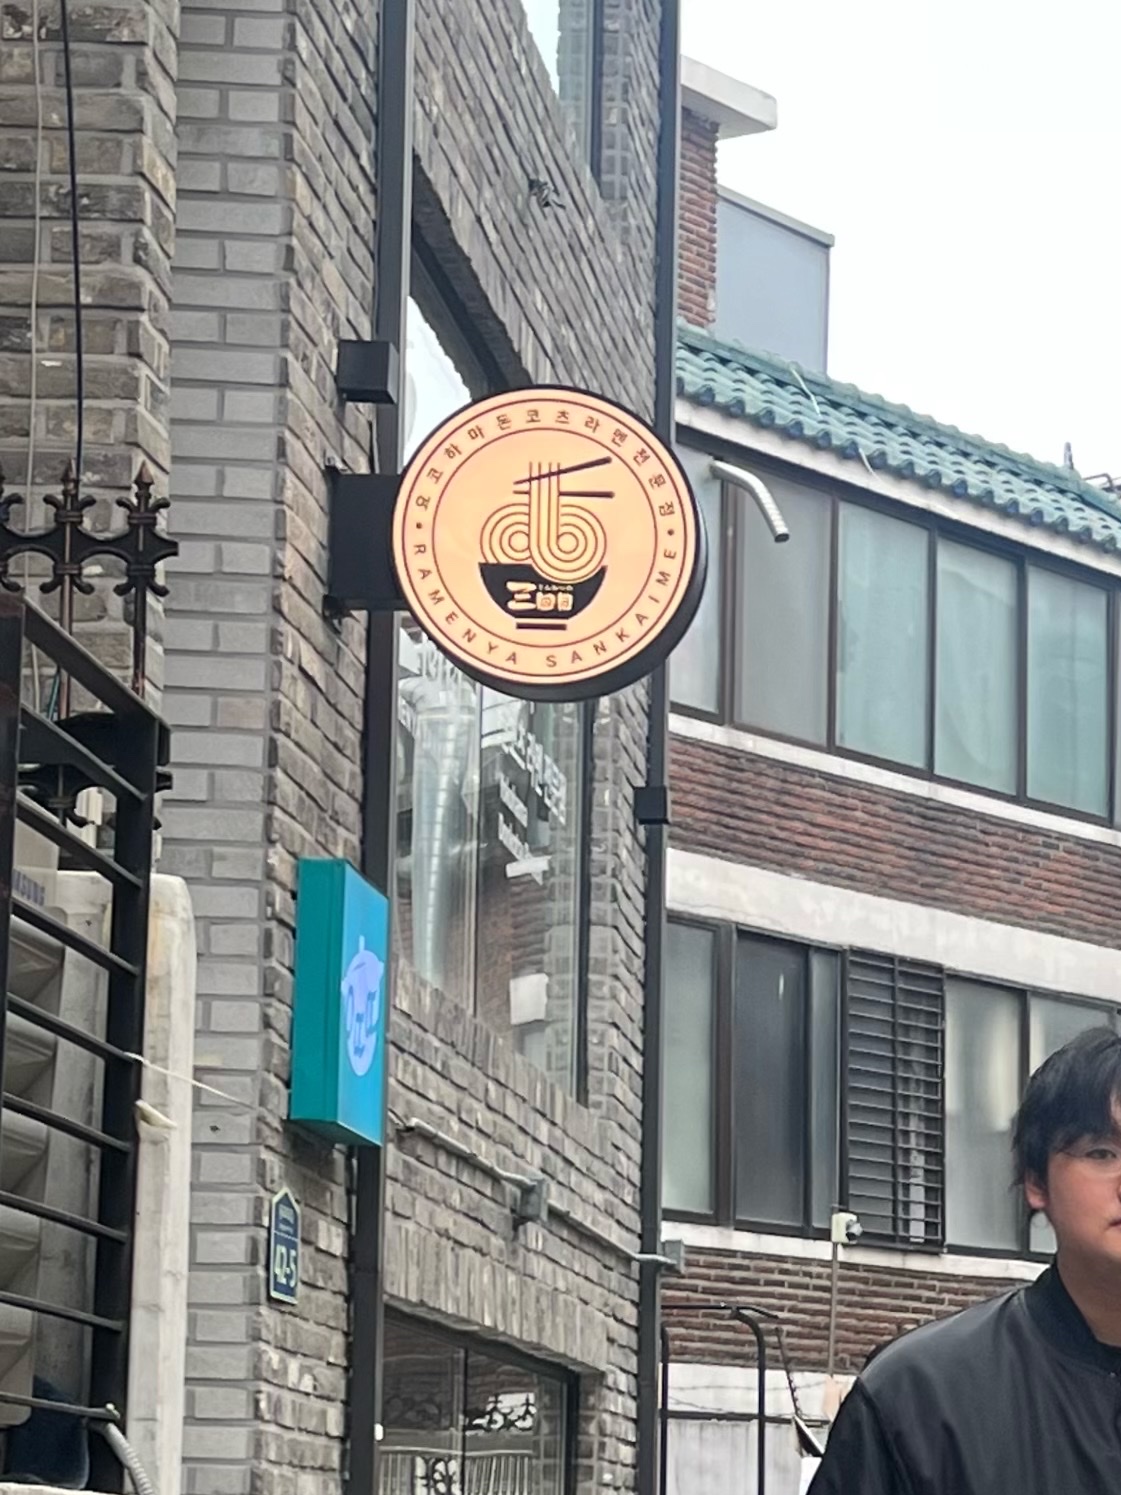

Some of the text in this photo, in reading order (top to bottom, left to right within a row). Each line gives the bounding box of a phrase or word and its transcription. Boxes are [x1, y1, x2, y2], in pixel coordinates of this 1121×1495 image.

[413, 543, 521, 666] RAMENYA
[545, 548, 677, 669] SANKAIME
[275, 1244, 297, 1288] 42-5
